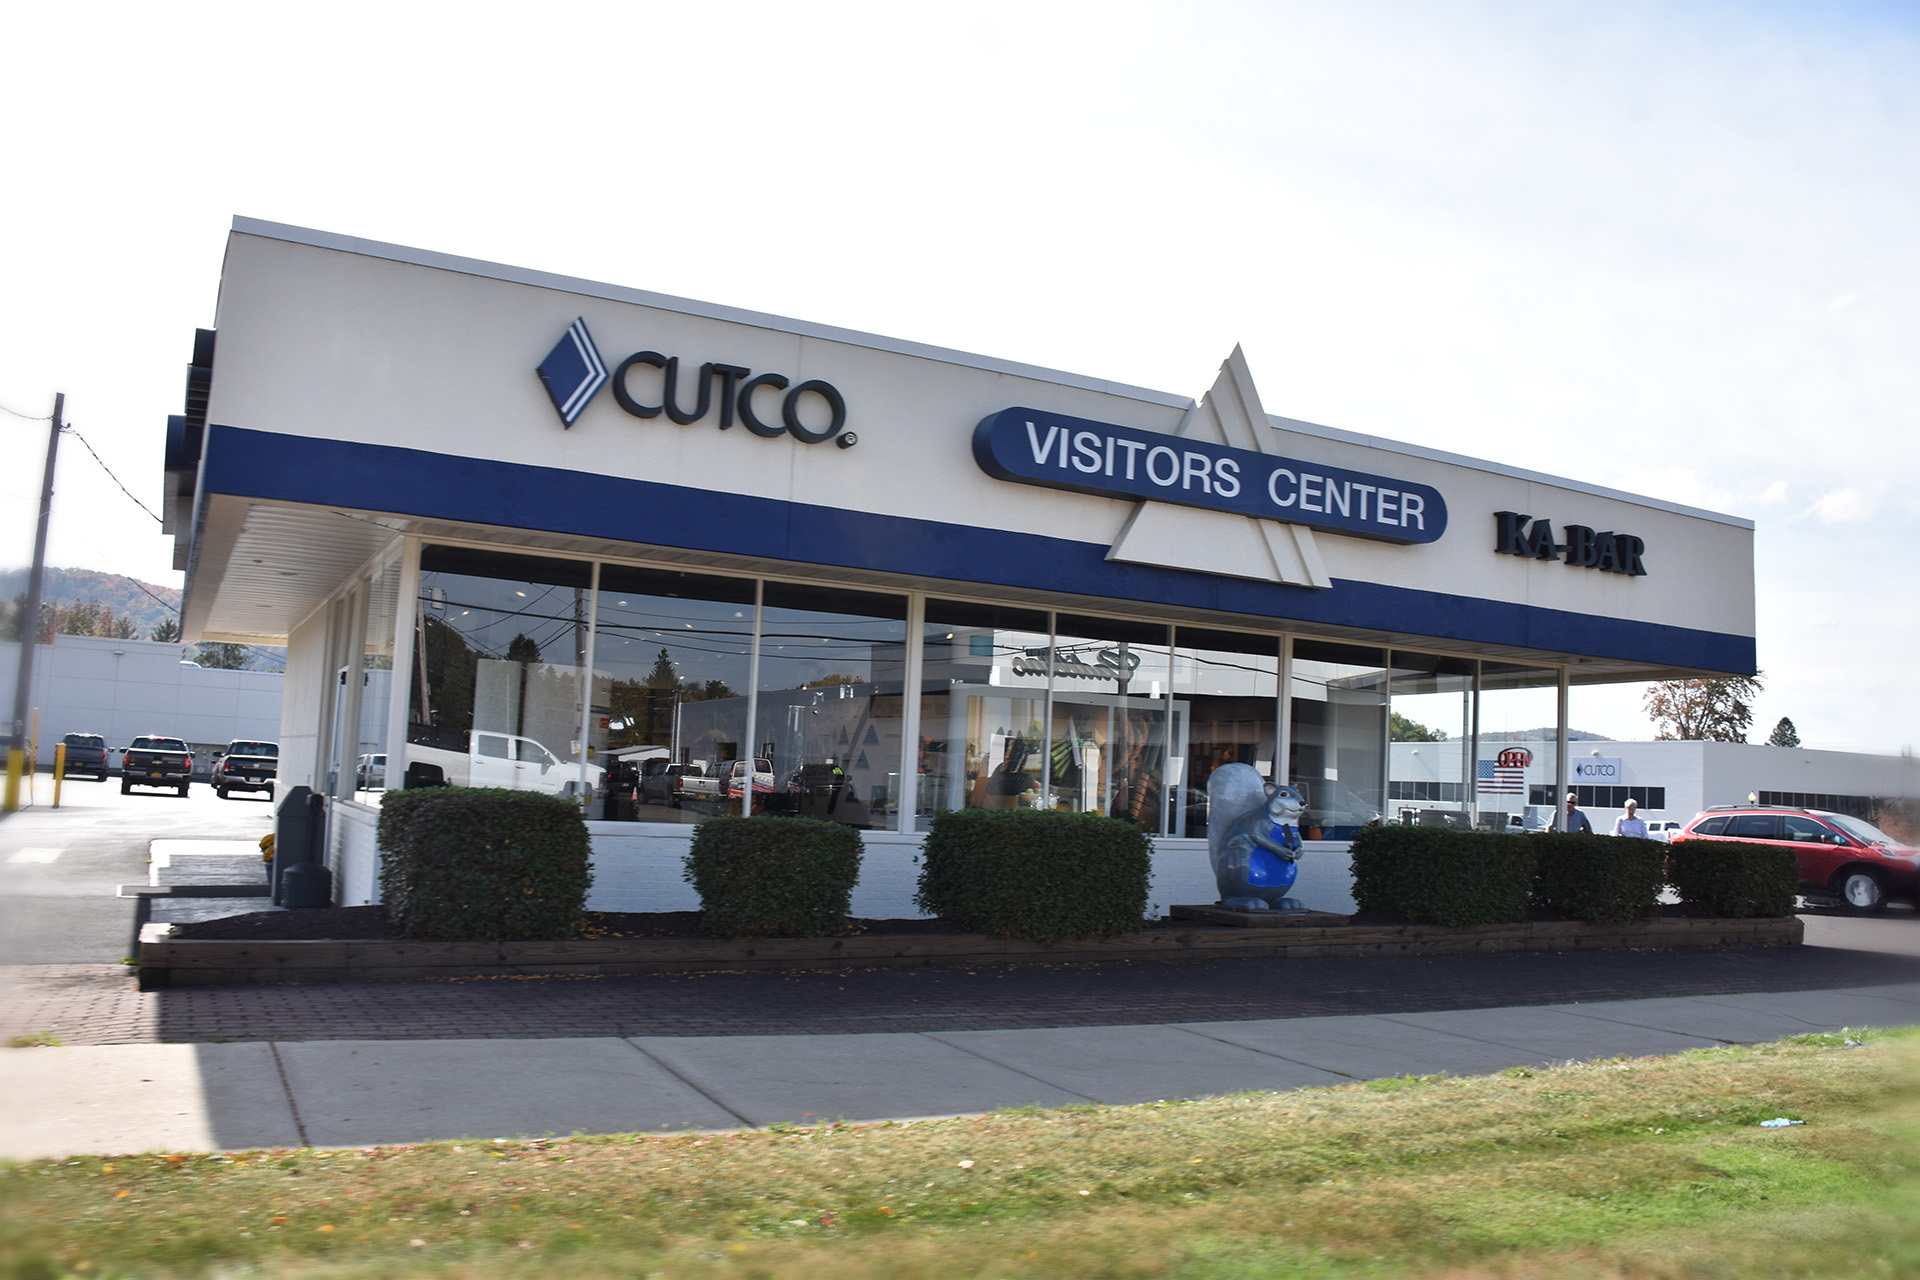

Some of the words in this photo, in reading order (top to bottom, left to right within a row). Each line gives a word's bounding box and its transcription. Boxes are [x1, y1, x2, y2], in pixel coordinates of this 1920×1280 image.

[612, 350, 846, 444] CUTCO
[1025, 421, 1241, 498] VISITORS
[1268, 468, 1425, 531] CENTER
[1493, 511, 1647, 576] KA-BAR
[1501, 751, 1532, 768] OPEN
[1583, 764, 1616, 776] CUTCO
